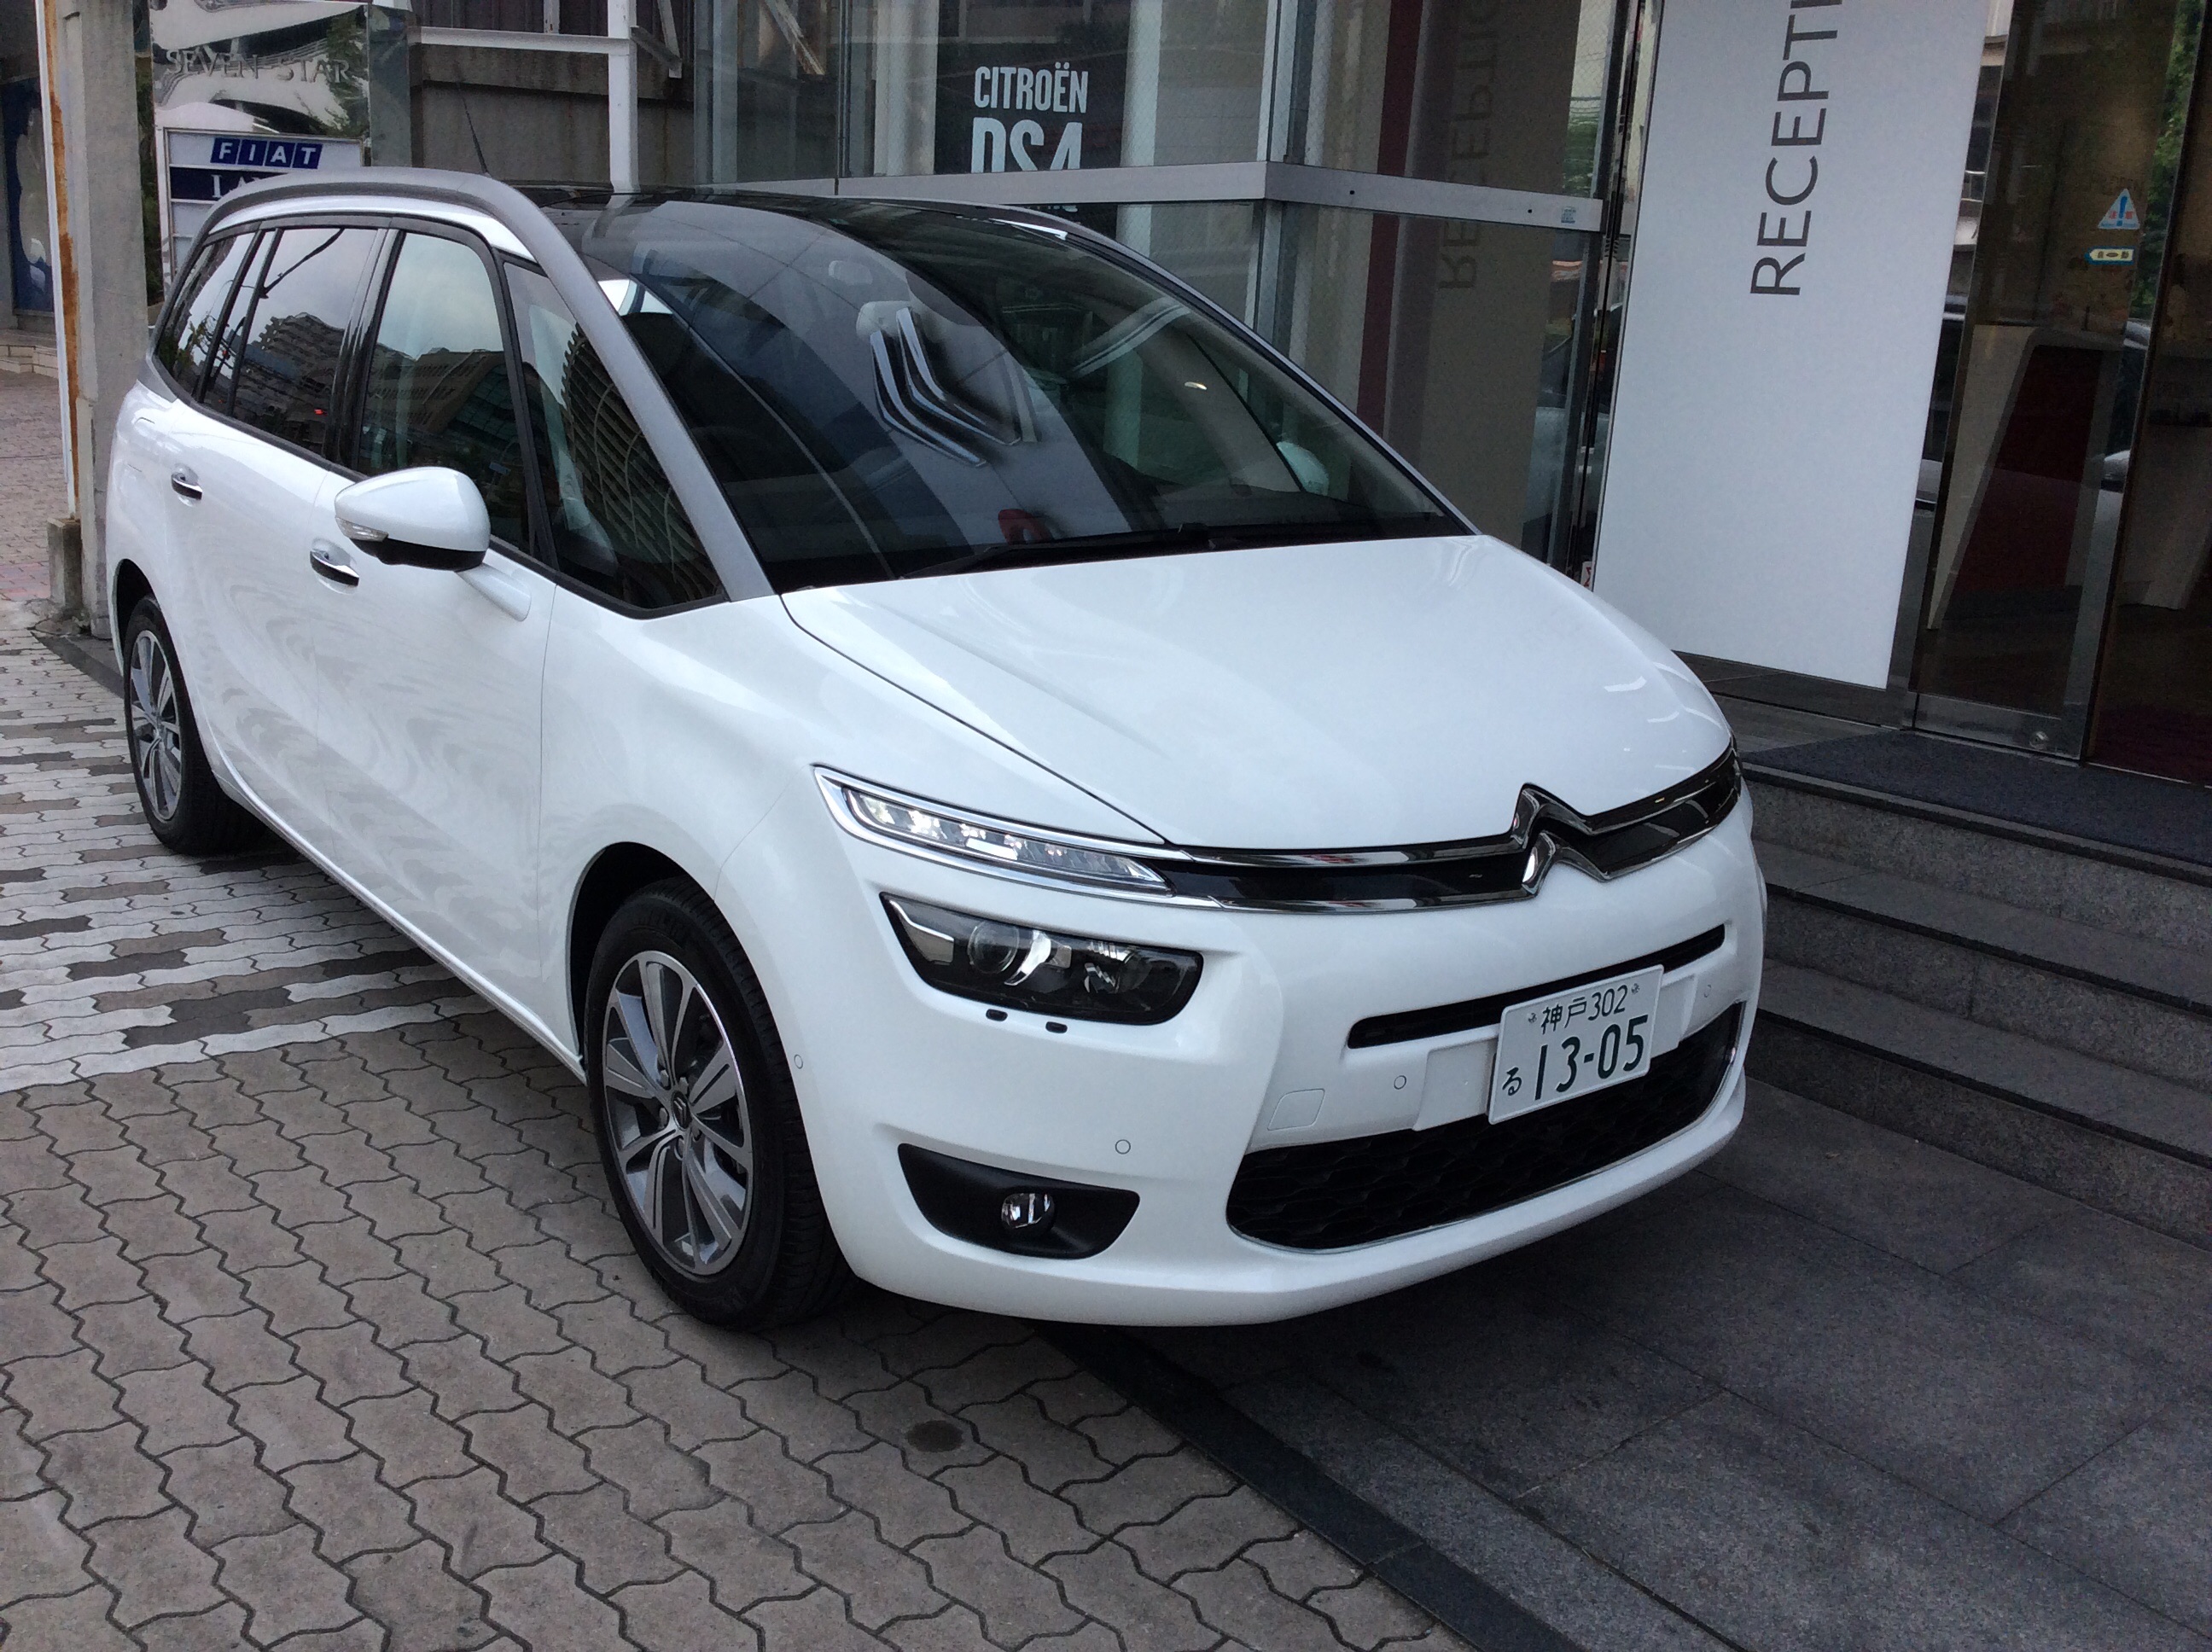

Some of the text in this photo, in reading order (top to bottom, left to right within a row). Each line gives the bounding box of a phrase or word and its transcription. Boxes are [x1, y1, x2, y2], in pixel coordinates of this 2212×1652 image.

[166, 46, 350, 84] SEVEN STAR
[975, 61, 1089, 113] CITROËN
[218, 142, 317, 166] FIAT
[1502, 1014, 1649, 1101] る 13-05
